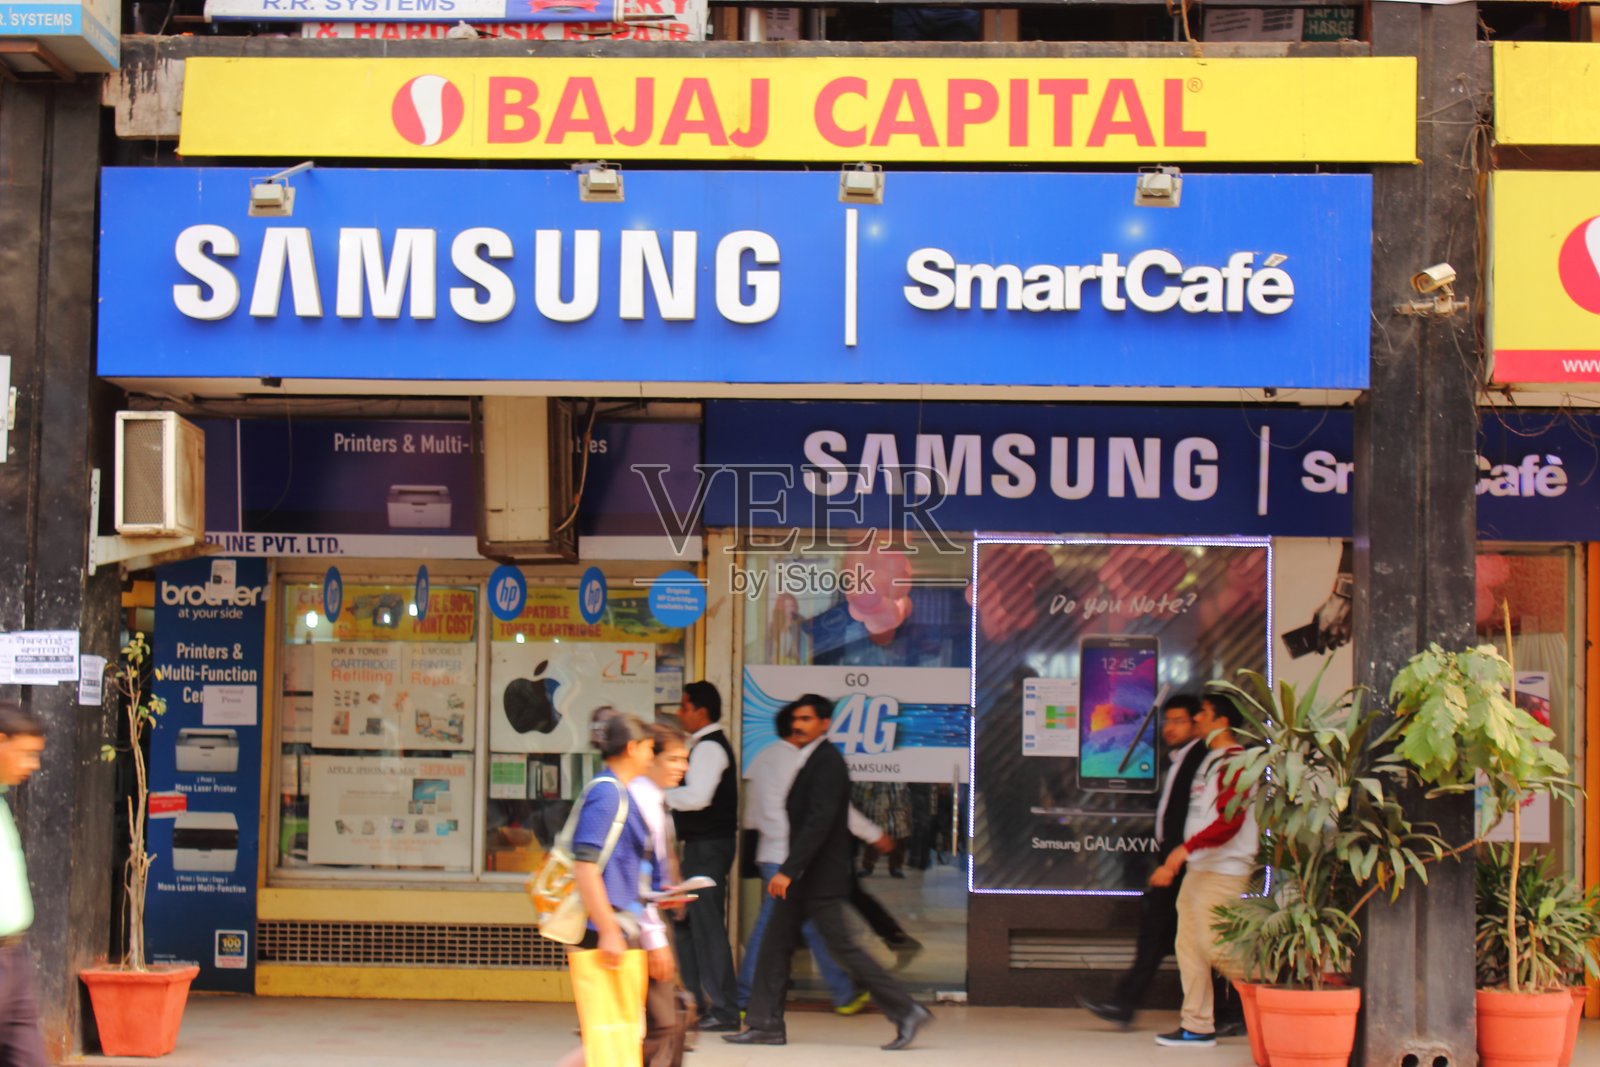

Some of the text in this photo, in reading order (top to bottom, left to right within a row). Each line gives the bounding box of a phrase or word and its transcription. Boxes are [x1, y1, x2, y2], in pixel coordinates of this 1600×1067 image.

[10, 13, 73, 26] SYSTEMS
[487, 76, 770, 148] BAJAJ
[172, 223, 782, 324] SAMSUNG
[334, 432, 398, 454] Printers
[403, 434, 416, 454] &
[803, 430, 1220, 500] SAMSUNG
[263, 535, 301, 554] PVT.
[307, 536, 345, 555] LTD.
[178, 607, 244, 621] at your side
[1050, 592, 1199, 619] Do you Note?
[499, 622, 603, 638] TONER CARTRIDGE
[176, 642, 244, 660] Printers &
[331, 658, 397, 670] CARTRIDGE
[411, 659, 463, 671] PRINTER
[160, 664, 258, 683] Multi-Function
[331, 669, 394, 686] Refilling
[845, 673, 870, 687] GO
[828, 692, 900, 755] 4G
[1031, 836, 1081, 853] Samsung
[222, 937, 242, 949] 100
